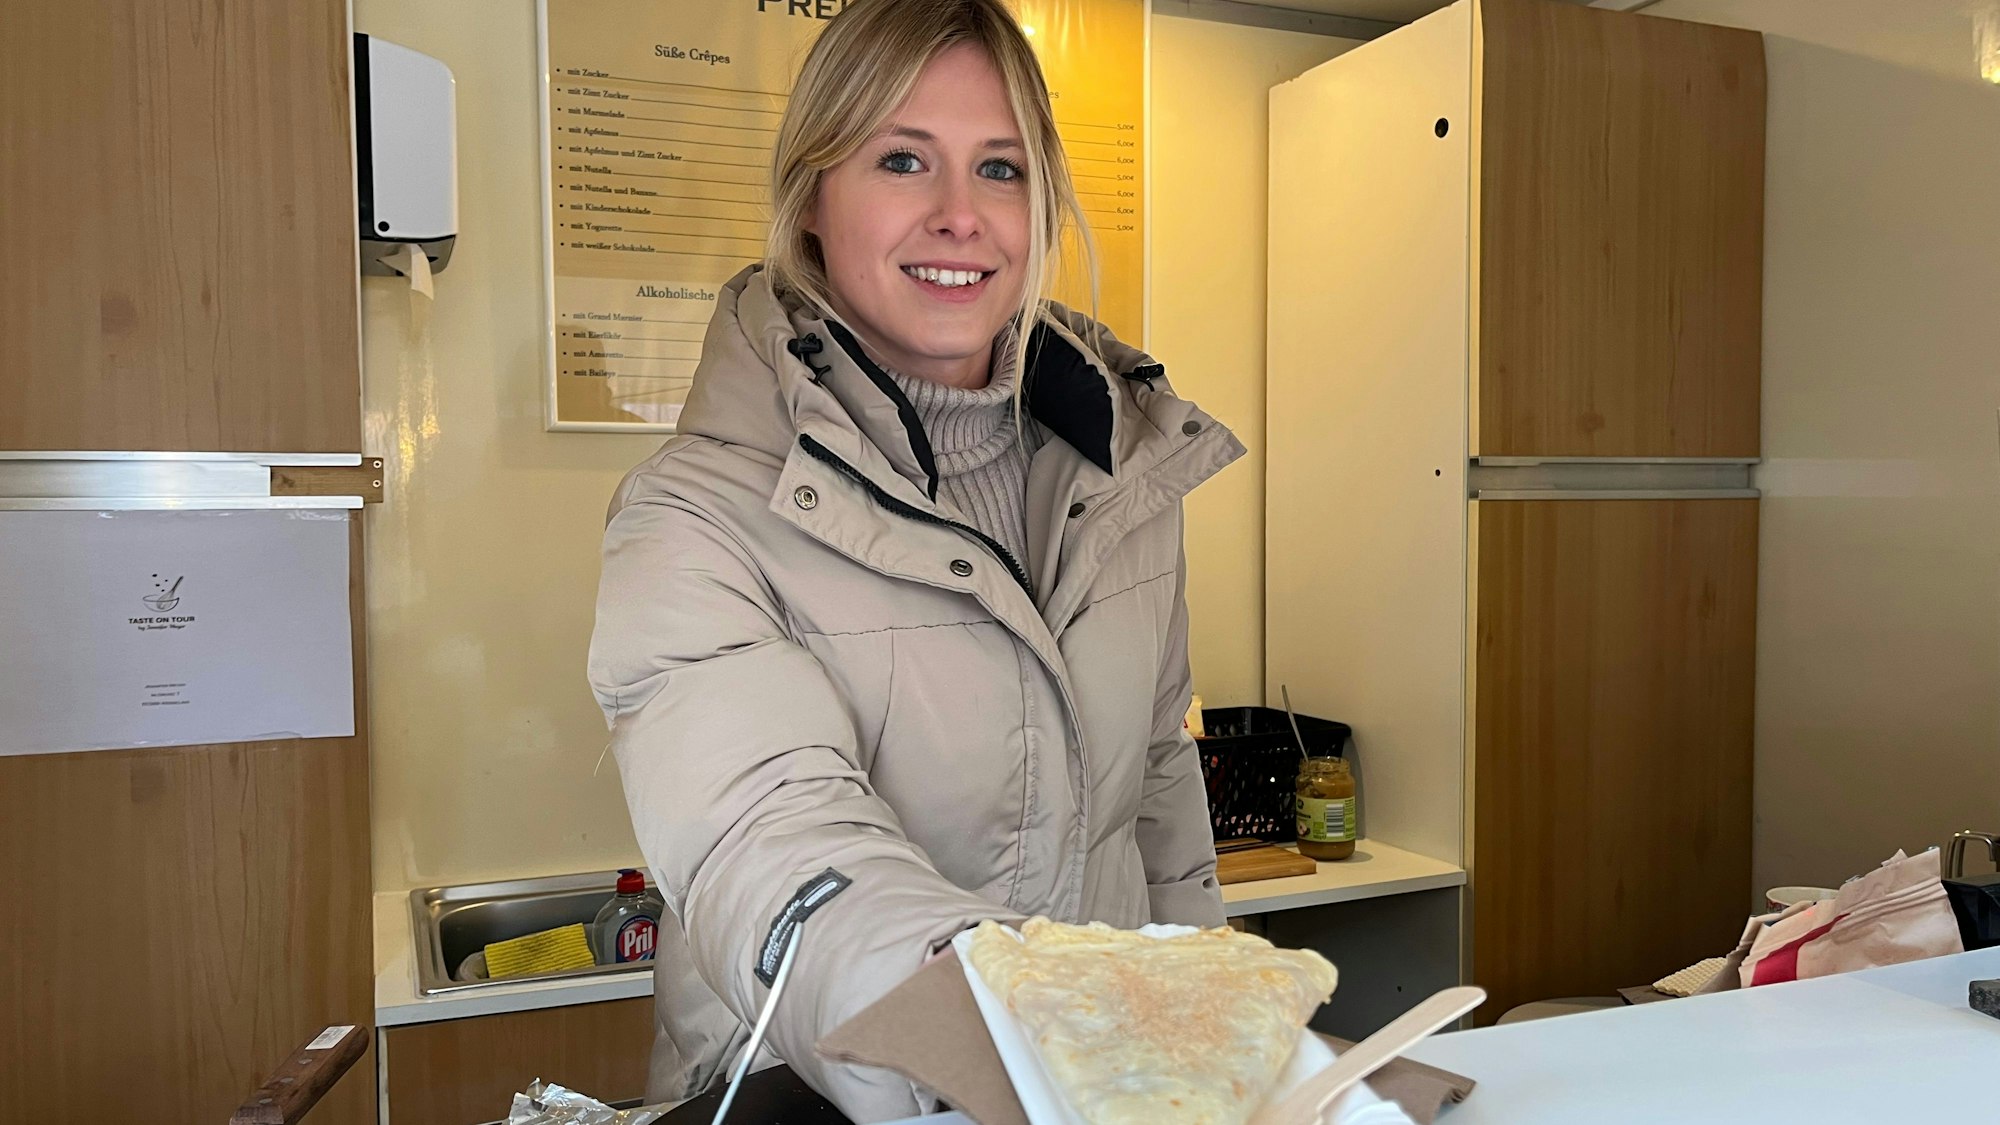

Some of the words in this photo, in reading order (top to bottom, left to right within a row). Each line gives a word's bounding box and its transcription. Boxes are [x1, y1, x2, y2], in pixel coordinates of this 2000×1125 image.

[655, 44, 686, 58] Süße
[690, 48, 730, 65] Crêpes
[582, 69, 609, 78] Zucker
[603, 90, 630, 99] Zucker
[583, 108, 625, 118] Marmelade
[657, 152, 682, 161] Zucker
[584, 165, 612, 174] Nutella
[585, 184, 612, 193] Nutella
[585, 203, 651, 215] Kinderschokolade
[586, 242, 611, 250] weißer
[613, 243, 656, 252] Schokolade
[636, 286, 715, 300] Alkoholische
[588, 312, 611, 320] Grand
[624, 925, 653, 958] Pril
